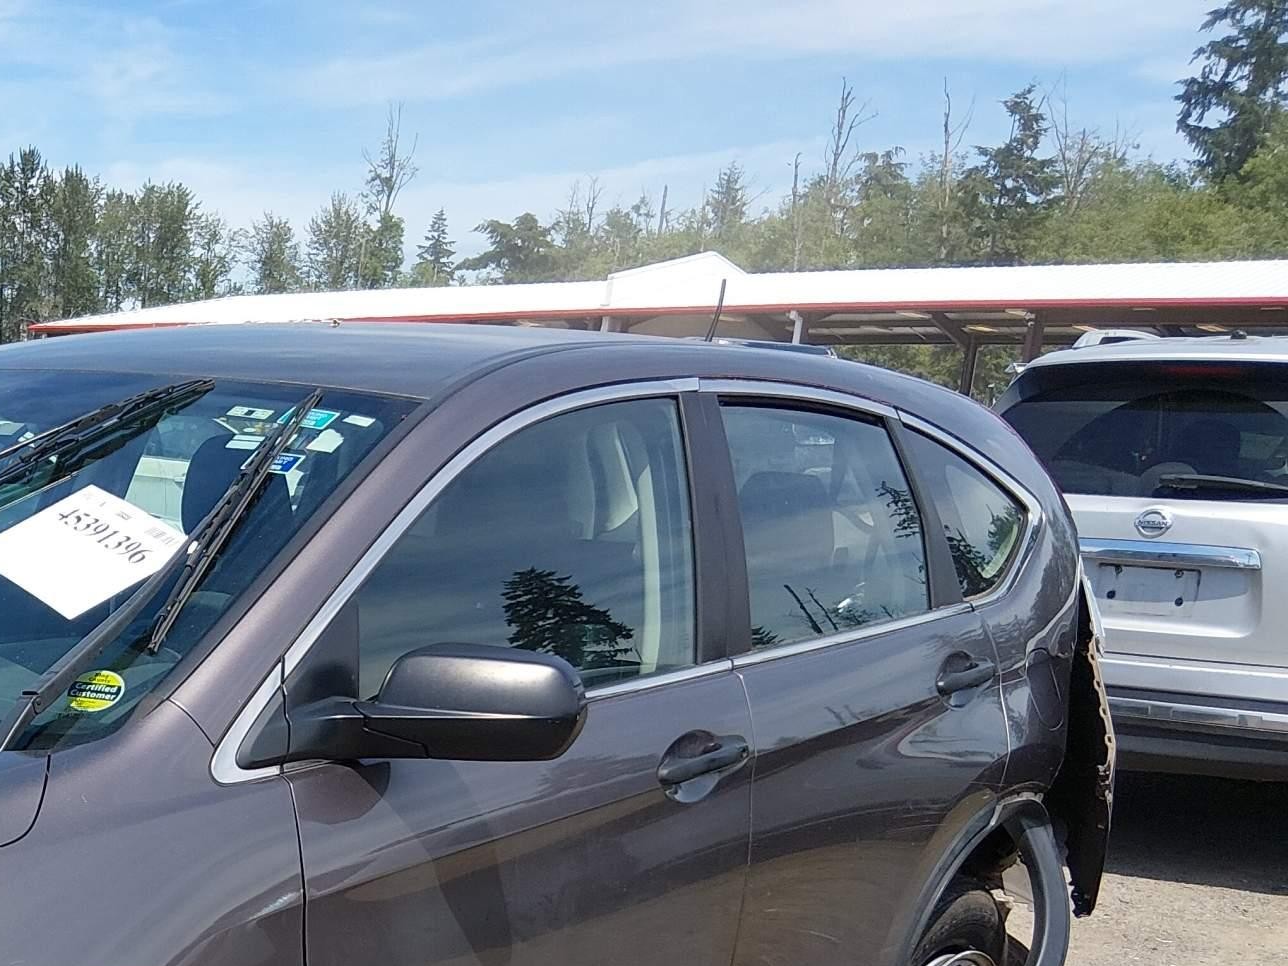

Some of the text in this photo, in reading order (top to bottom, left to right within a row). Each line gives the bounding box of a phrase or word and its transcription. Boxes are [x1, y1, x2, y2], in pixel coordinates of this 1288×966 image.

[56, 507, 150, 565] 45391396
[75, 682, 118, 694] Certified
[70, 689, 116, 701] Customer
